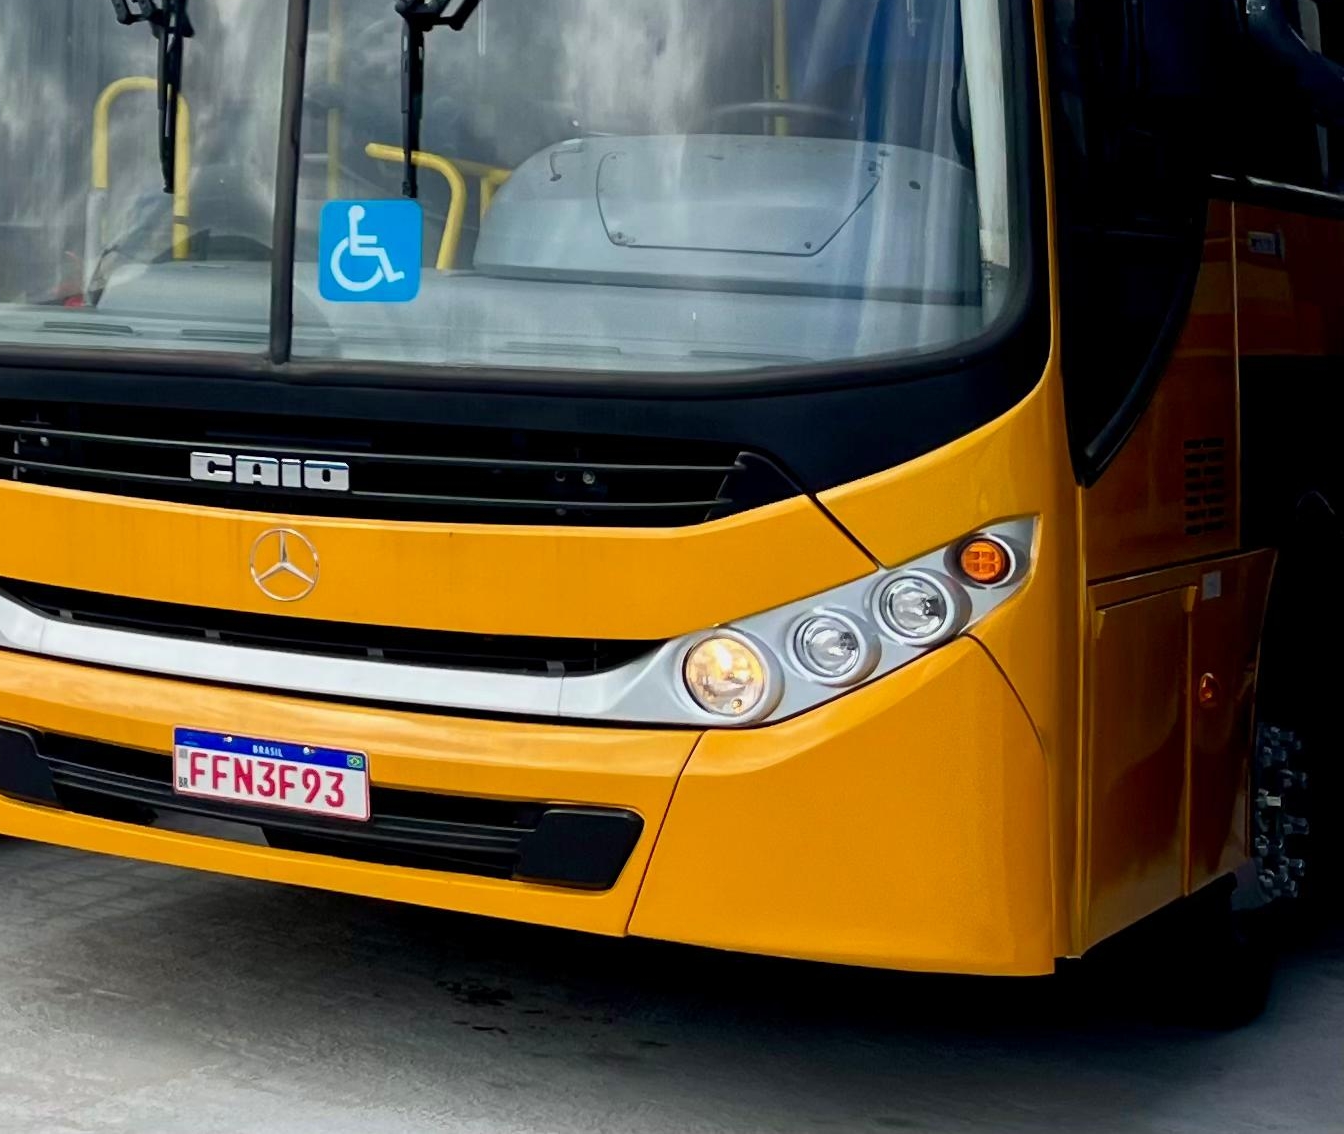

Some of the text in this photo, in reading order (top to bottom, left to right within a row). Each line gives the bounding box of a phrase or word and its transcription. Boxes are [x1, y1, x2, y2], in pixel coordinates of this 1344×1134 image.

[190, 451, 350, 492] CAIO
[252, 744, 283, 758] BRASIL
[190, 752, 345, 808] FFN3F93
